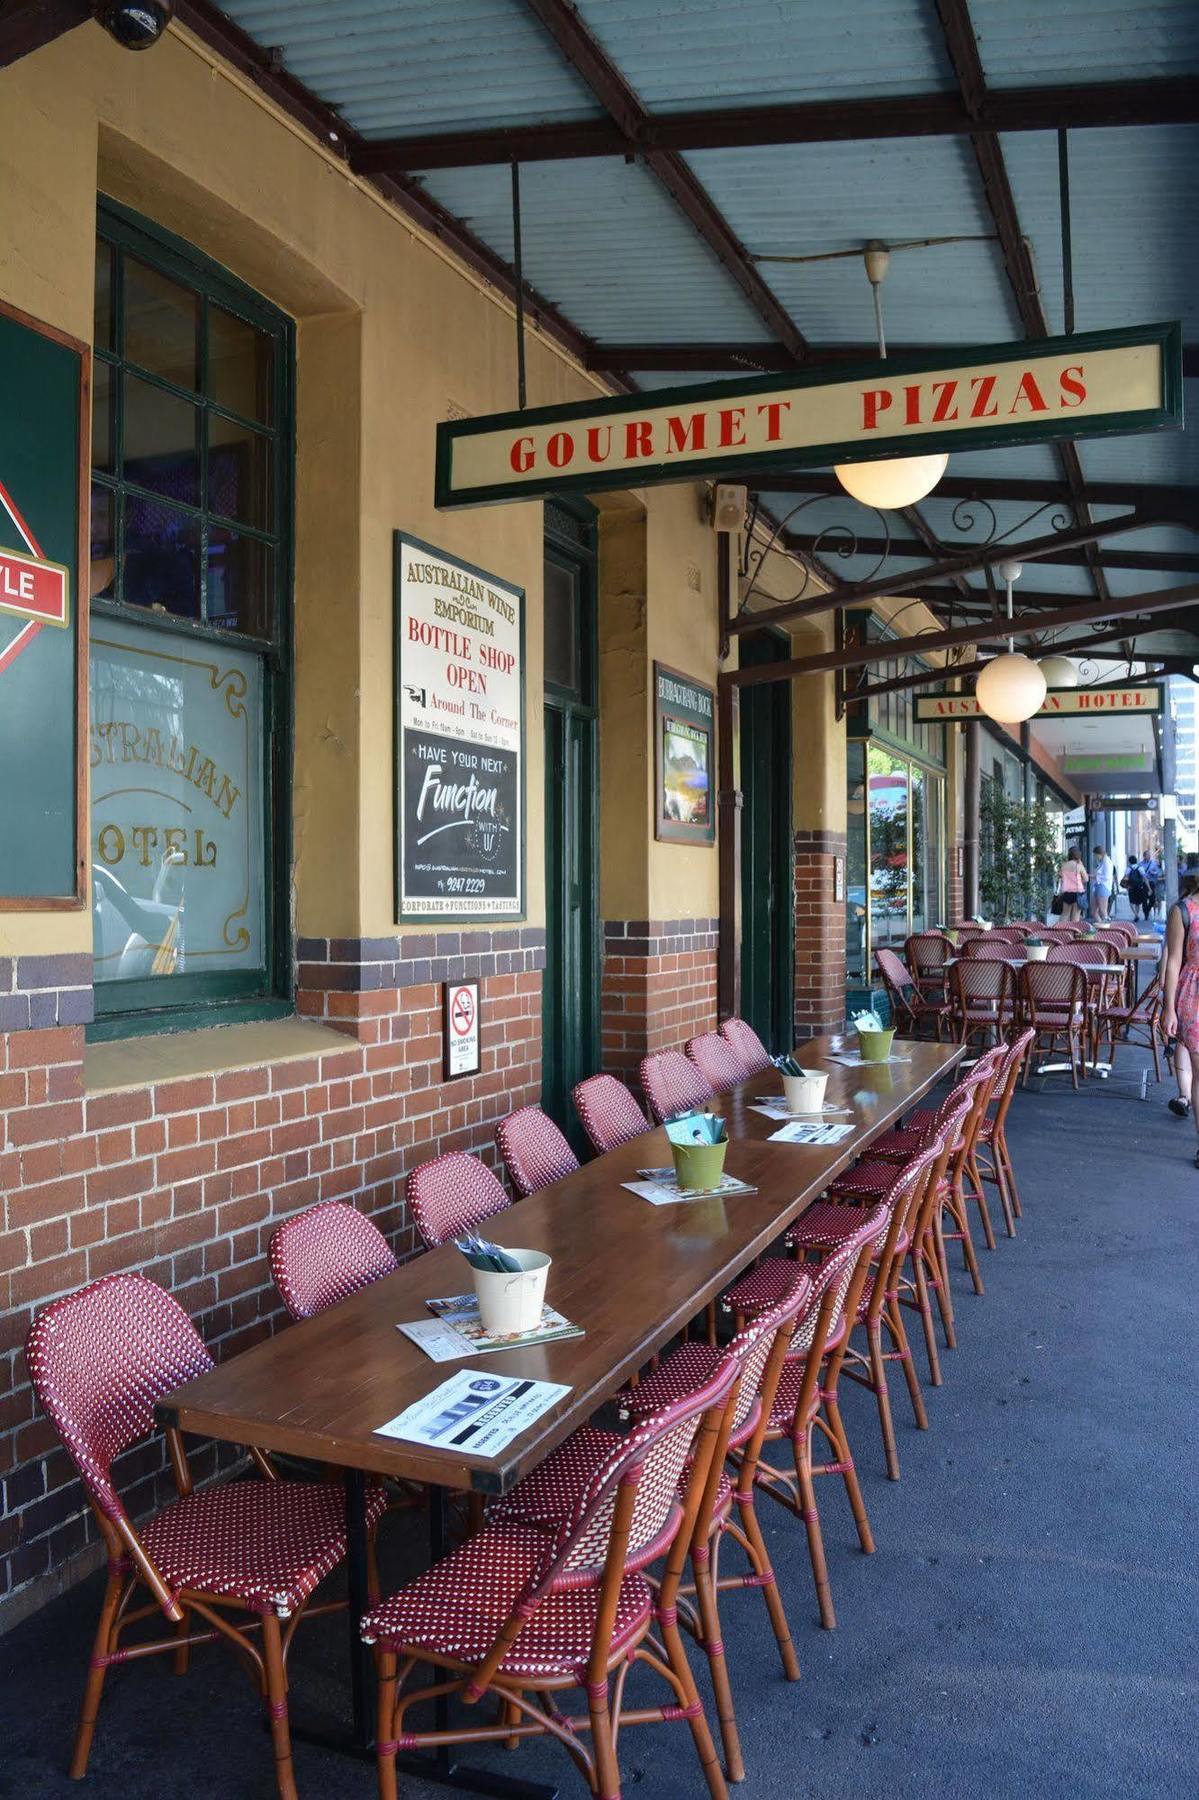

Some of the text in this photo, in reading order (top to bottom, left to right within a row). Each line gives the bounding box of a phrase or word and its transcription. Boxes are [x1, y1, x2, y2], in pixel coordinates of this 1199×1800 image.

[509, 366, 1087, 473] GOURMET PIZZAS
[0, 566, 35, 601] LE
[407, 563, 515, 625] AUSTRALIAN WINE
[433, 597, 495, 637] EMPORIUM
[408, 616, 515, 675] BOTTLE SHOP
[447, 663, 487, 695] OPEN
[431, 692, 518, 730] Around The Corner
[1079, 693, 1147, 709] HOTEL
[418, 744, 502, 773] HAVE YOUR NEXT
[416, 764, 497, 821] Function
[479, 822, 498, 832] WITH
[447, 876, 466, 892] 9247
[465, 878, 485, 893] 2229
[402, 901, 444, 912] CORPORATE
